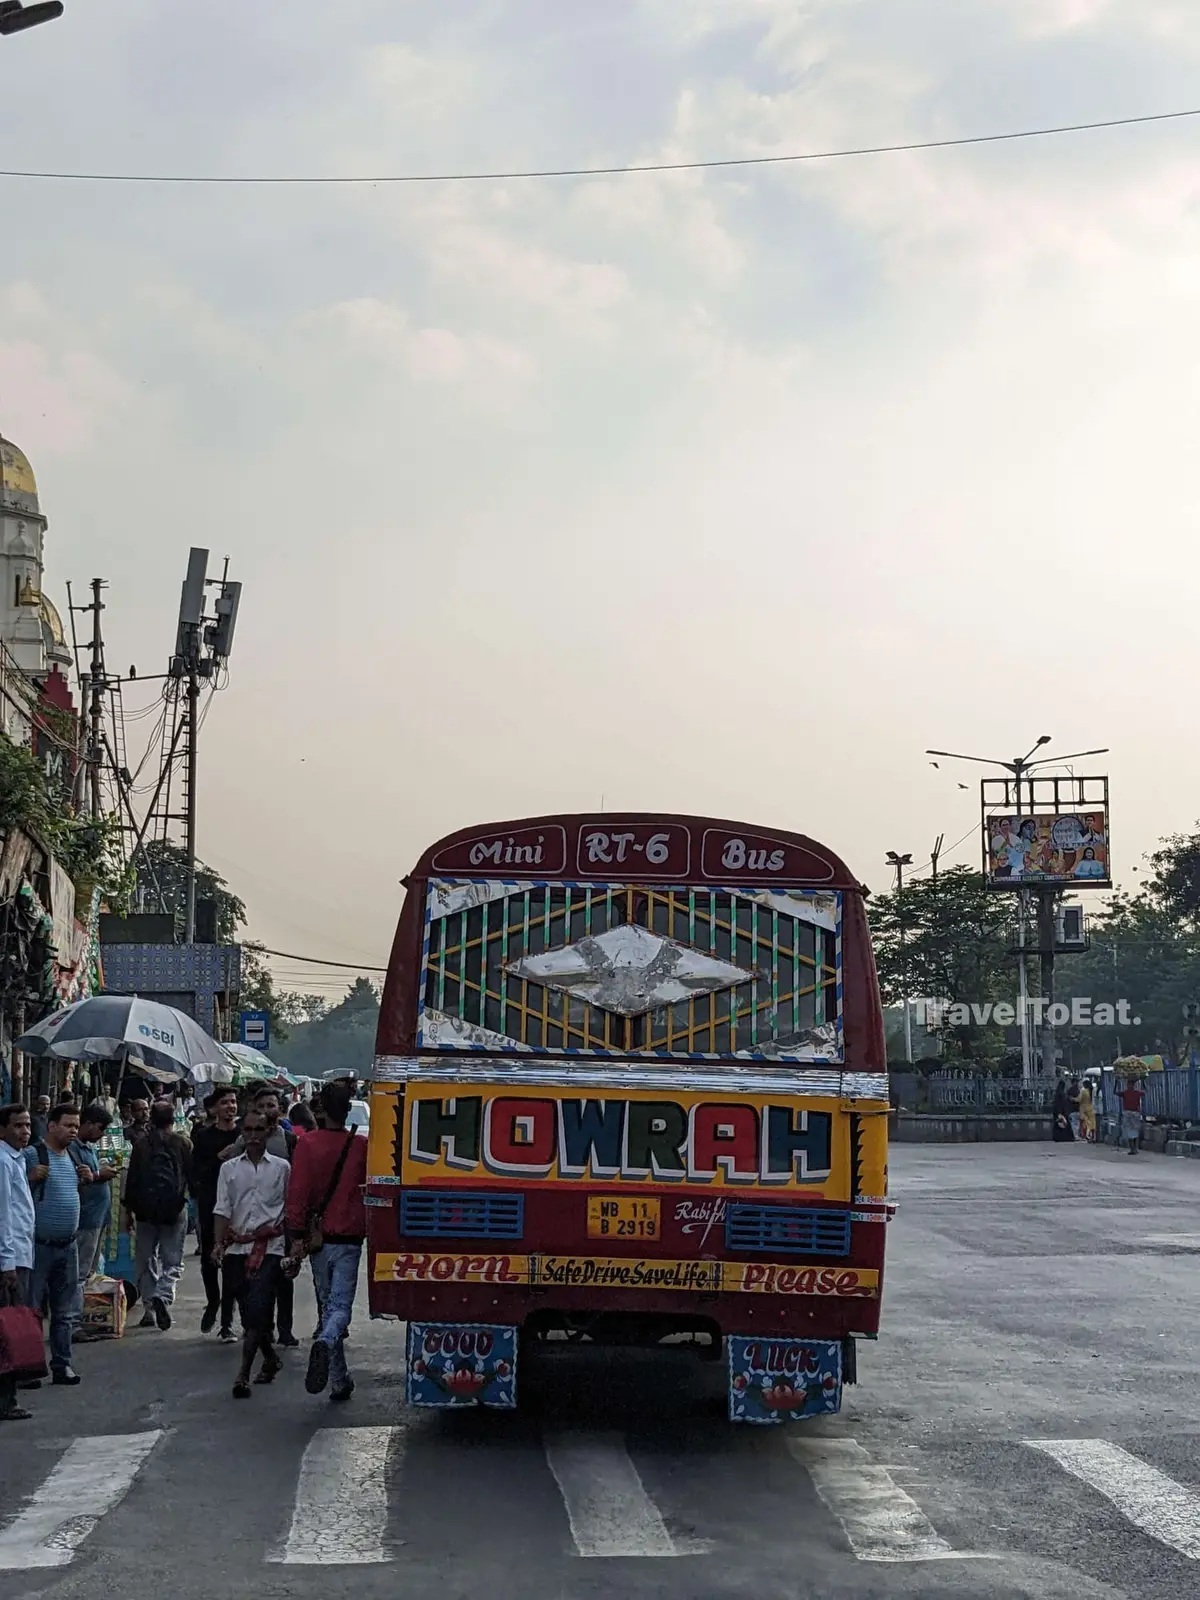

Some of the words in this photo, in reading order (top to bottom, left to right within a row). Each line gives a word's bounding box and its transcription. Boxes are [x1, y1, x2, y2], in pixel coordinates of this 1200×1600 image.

[469, 835, 545, 865] Mini
[585, 832, 671, 864] RT-6
[721, 838, 785, 871] Bus
[152, 1029, 174, 1046] SBI
[411, 1096, 832, 1184] HOWRAH
[601, 1202, 618, 1217] WB
[632, 1203, 647, 1218] 11
[601, 1219, 609, 1234] B
[393, 1254, 519, 1282] Horn
[741, 1264, 872, 1297] Please
[422, 1328, 494, 1360] GOOD
[743, 1343, 821, 1378] LUCK
